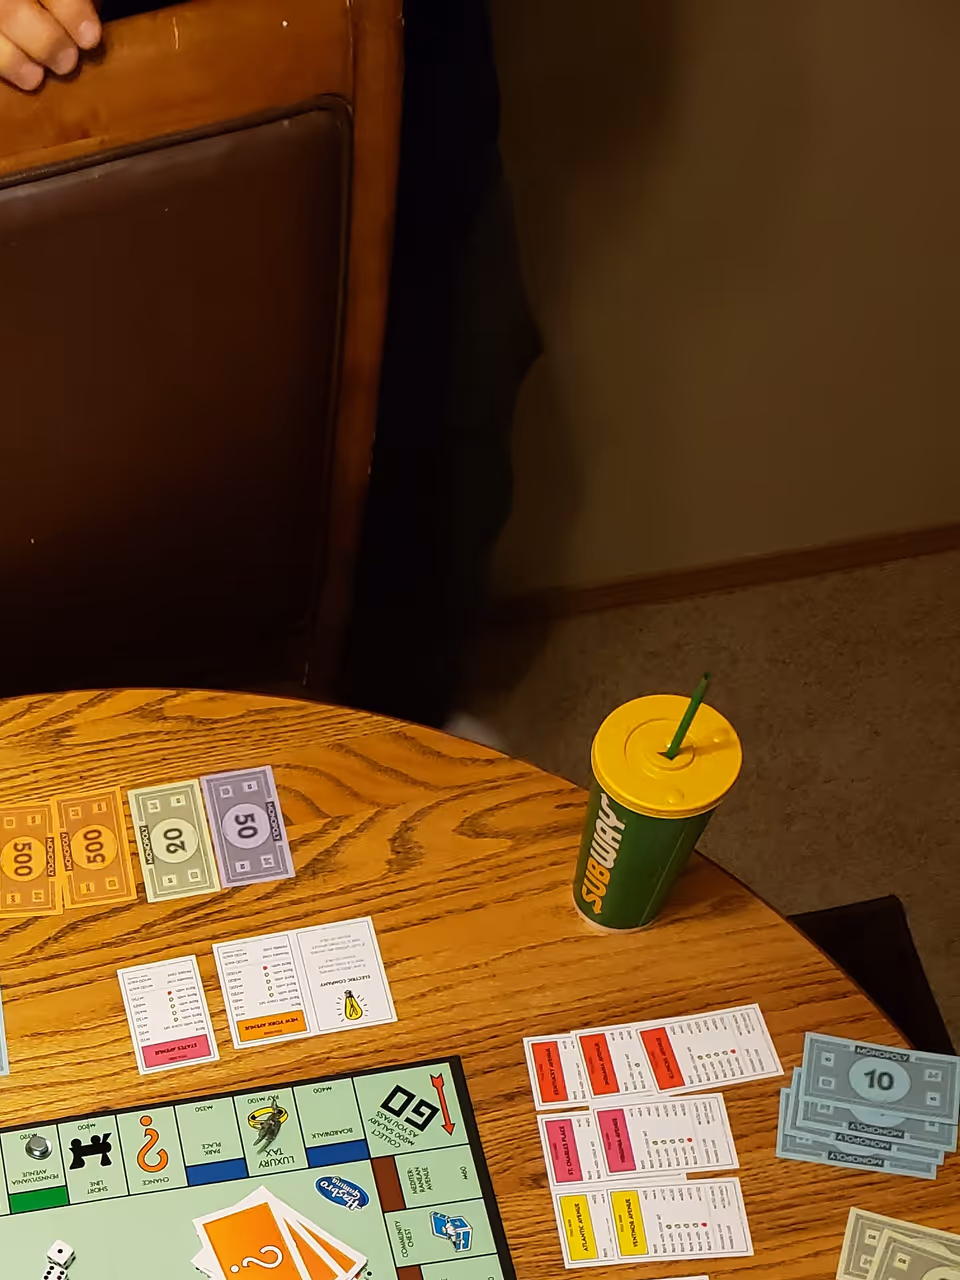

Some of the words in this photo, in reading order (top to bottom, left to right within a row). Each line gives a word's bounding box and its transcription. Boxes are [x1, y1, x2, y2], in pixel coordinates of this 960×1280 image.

[235, 813, 258, 839] 50
[266, 802, 282, 841] MONOPOLY
[83, 829, 106, 865] 500
[140, 826, 154, 865] MONOPOLY
[163, 828, 187, 854] 20
[13, 842, 33, 877] 500
[46, 837, 55, 876] MONOPOLY
[60, 833, 73, 871] MONOPOLY
[581, 793, 626, 914] SUBWAY
[855, 1046, 910, 1062] MONOPOLY
[864, 1068, 894, 1091] 10
[376, 1111, 393, 1123] PASS
[380, 1084, 440, 1132] GO
[312, 1128, 353, 1139] BOARDWALK
[368, 1118, 394, 1134] SALARY
[394, 1121, 408, 1132] YOU
[408, 1130, 419, 1138] AS
[848, 1122, 904, 1139] MONOPOLY
[371, 1129, 401, 1148] COLLECT
[836, 1134, 891, 1150] MONOPOLY
[258, 1155, 296, 1169] LUXURY
[828, 1151, 884, 1167] MONOPOLY
[11, 1174, 59, 1186] PENNSYLVANIA
[141, 1177, 170, 1186] CHANCE
[86, 1186, 109, 1195] SHORT
[320, 1180, 362, 1211] Hasbro
[393, 1220, 409, 1258] COMMUNITY
